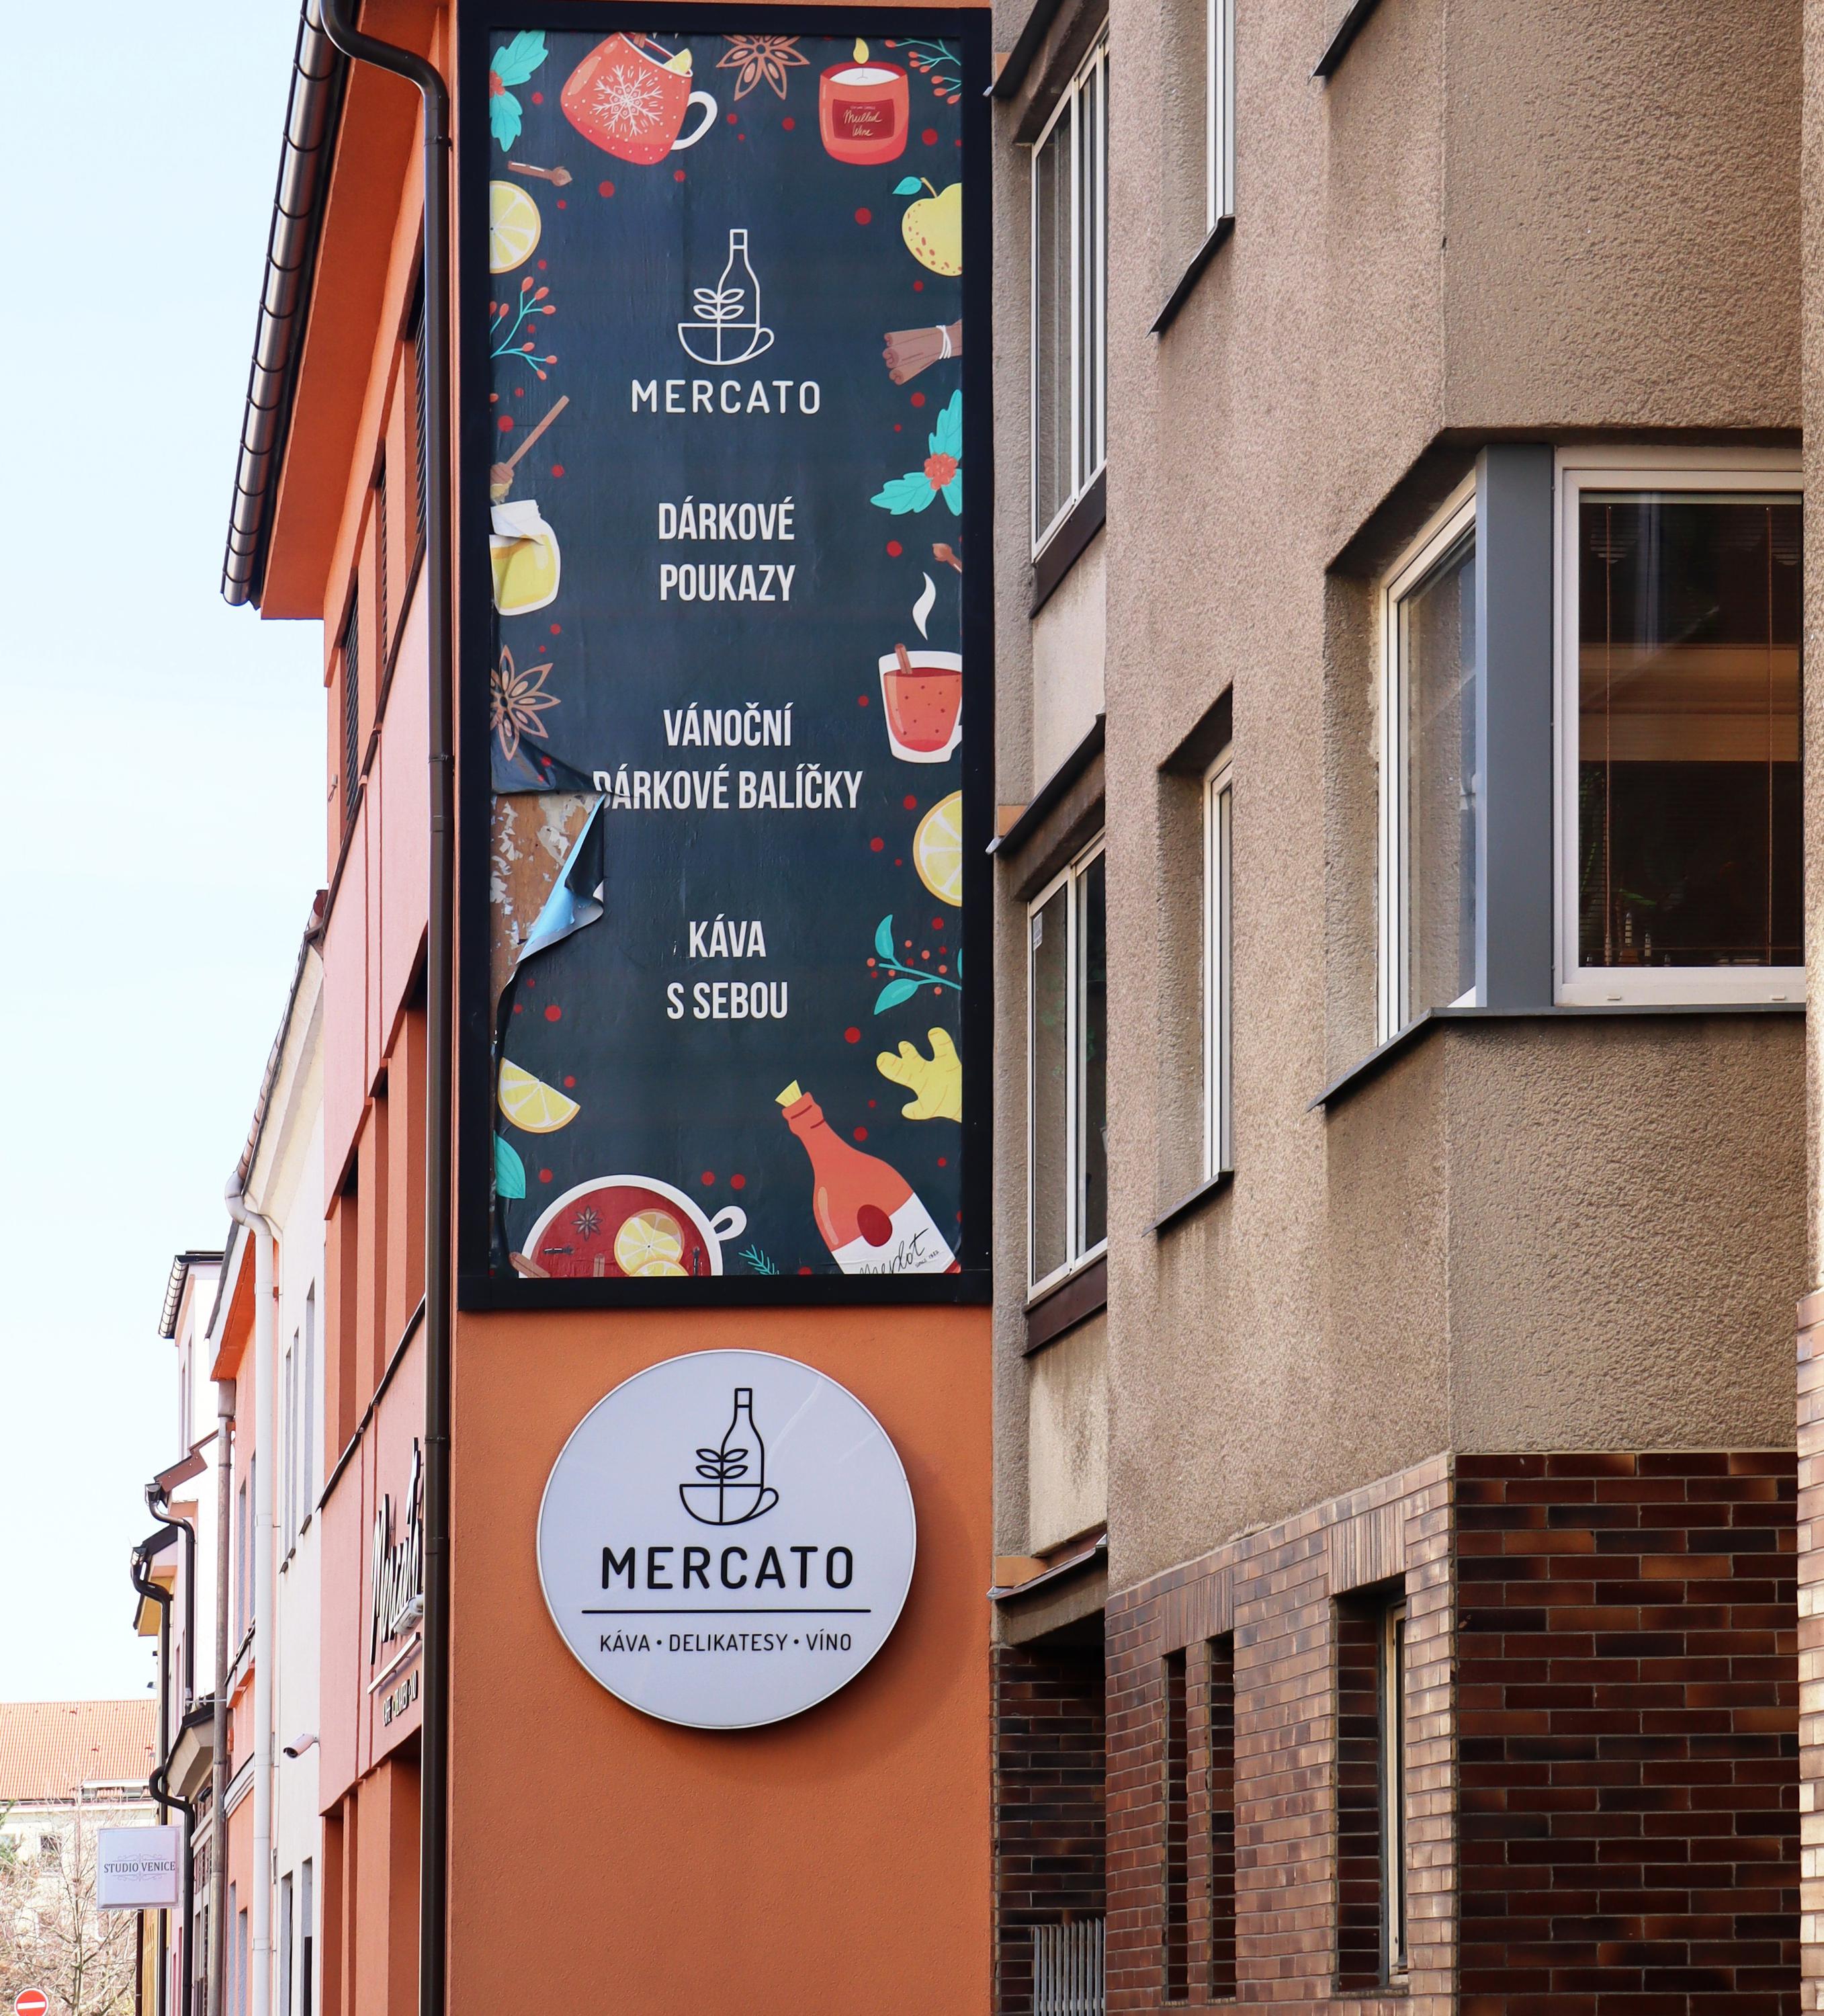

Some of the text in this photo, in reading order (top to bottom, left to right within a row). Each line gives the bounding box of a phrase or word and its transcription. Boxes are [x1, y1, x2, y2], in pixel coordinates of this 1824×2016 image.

[843, 110, 882, 124] Mulled
[632, 379, 820, 415] MERCATO
[658, 495, 795, 540] DÁRKOVÉ
[660, 564, 796, 601] POUKAZY
[663, 702, 793, 747] VÁNOČNÍ
[593, 763, 863, 809] DÁRKOVÉ BALÍČKY
[689, 913, 767, 958] KÁVA
[666, 981, 788, 1019] S SEBOU
[601, 1546, 853, 1590] MERCATO
[600, 1628, 852, 1652] KÁVA DELIKATESY VÍNO
[103, 1861, 176, 1874] STUDIO VENICE
